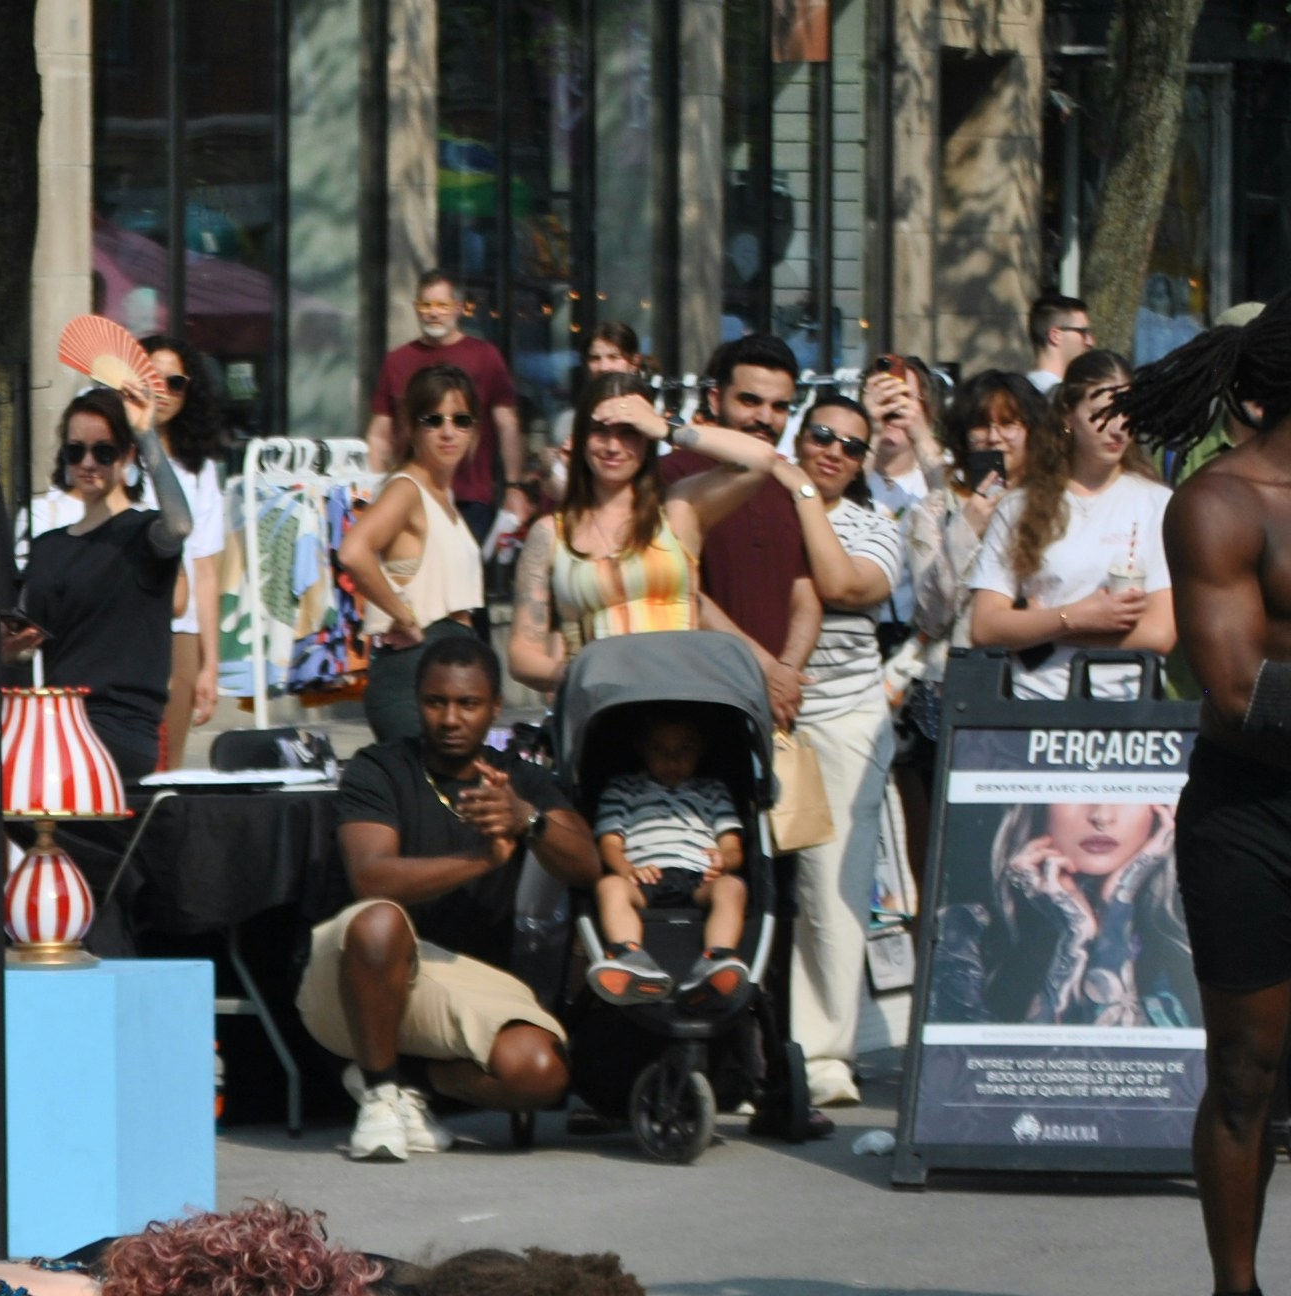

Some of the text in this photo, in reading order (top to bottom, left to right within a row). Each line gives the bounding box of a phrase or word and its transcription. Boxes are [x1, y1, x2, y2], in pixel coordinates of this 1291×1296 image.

[1027, 729, 1183, 772] PERÇAGES
[974, 783, 1043, 794] BIENVENUE
[1046, 783, 1080, 795] AVEC
[1081, 784, 1100, 795] OU
[1102, 784, 1133, 795] SANS
[967, 1059, 1185, 1074] ENTREZ VOIR NOTRE COLLECTION DE
[1031, 1072, 1104, 1085] CORPORELS
[1107, 1073, 1125, 1085] EN
[1126, 1073, 1145, 1086] OR
[1147, 1074, 1162, 1086] ET
[975, 1084, 1018, 1096] TITANE
[1020, 1085, 1037, 1097] DE
[1091, 1086, 1171, 1099] IMPLANTAIRE
[1041, 1125, 1099, 1142] ARAKNA
